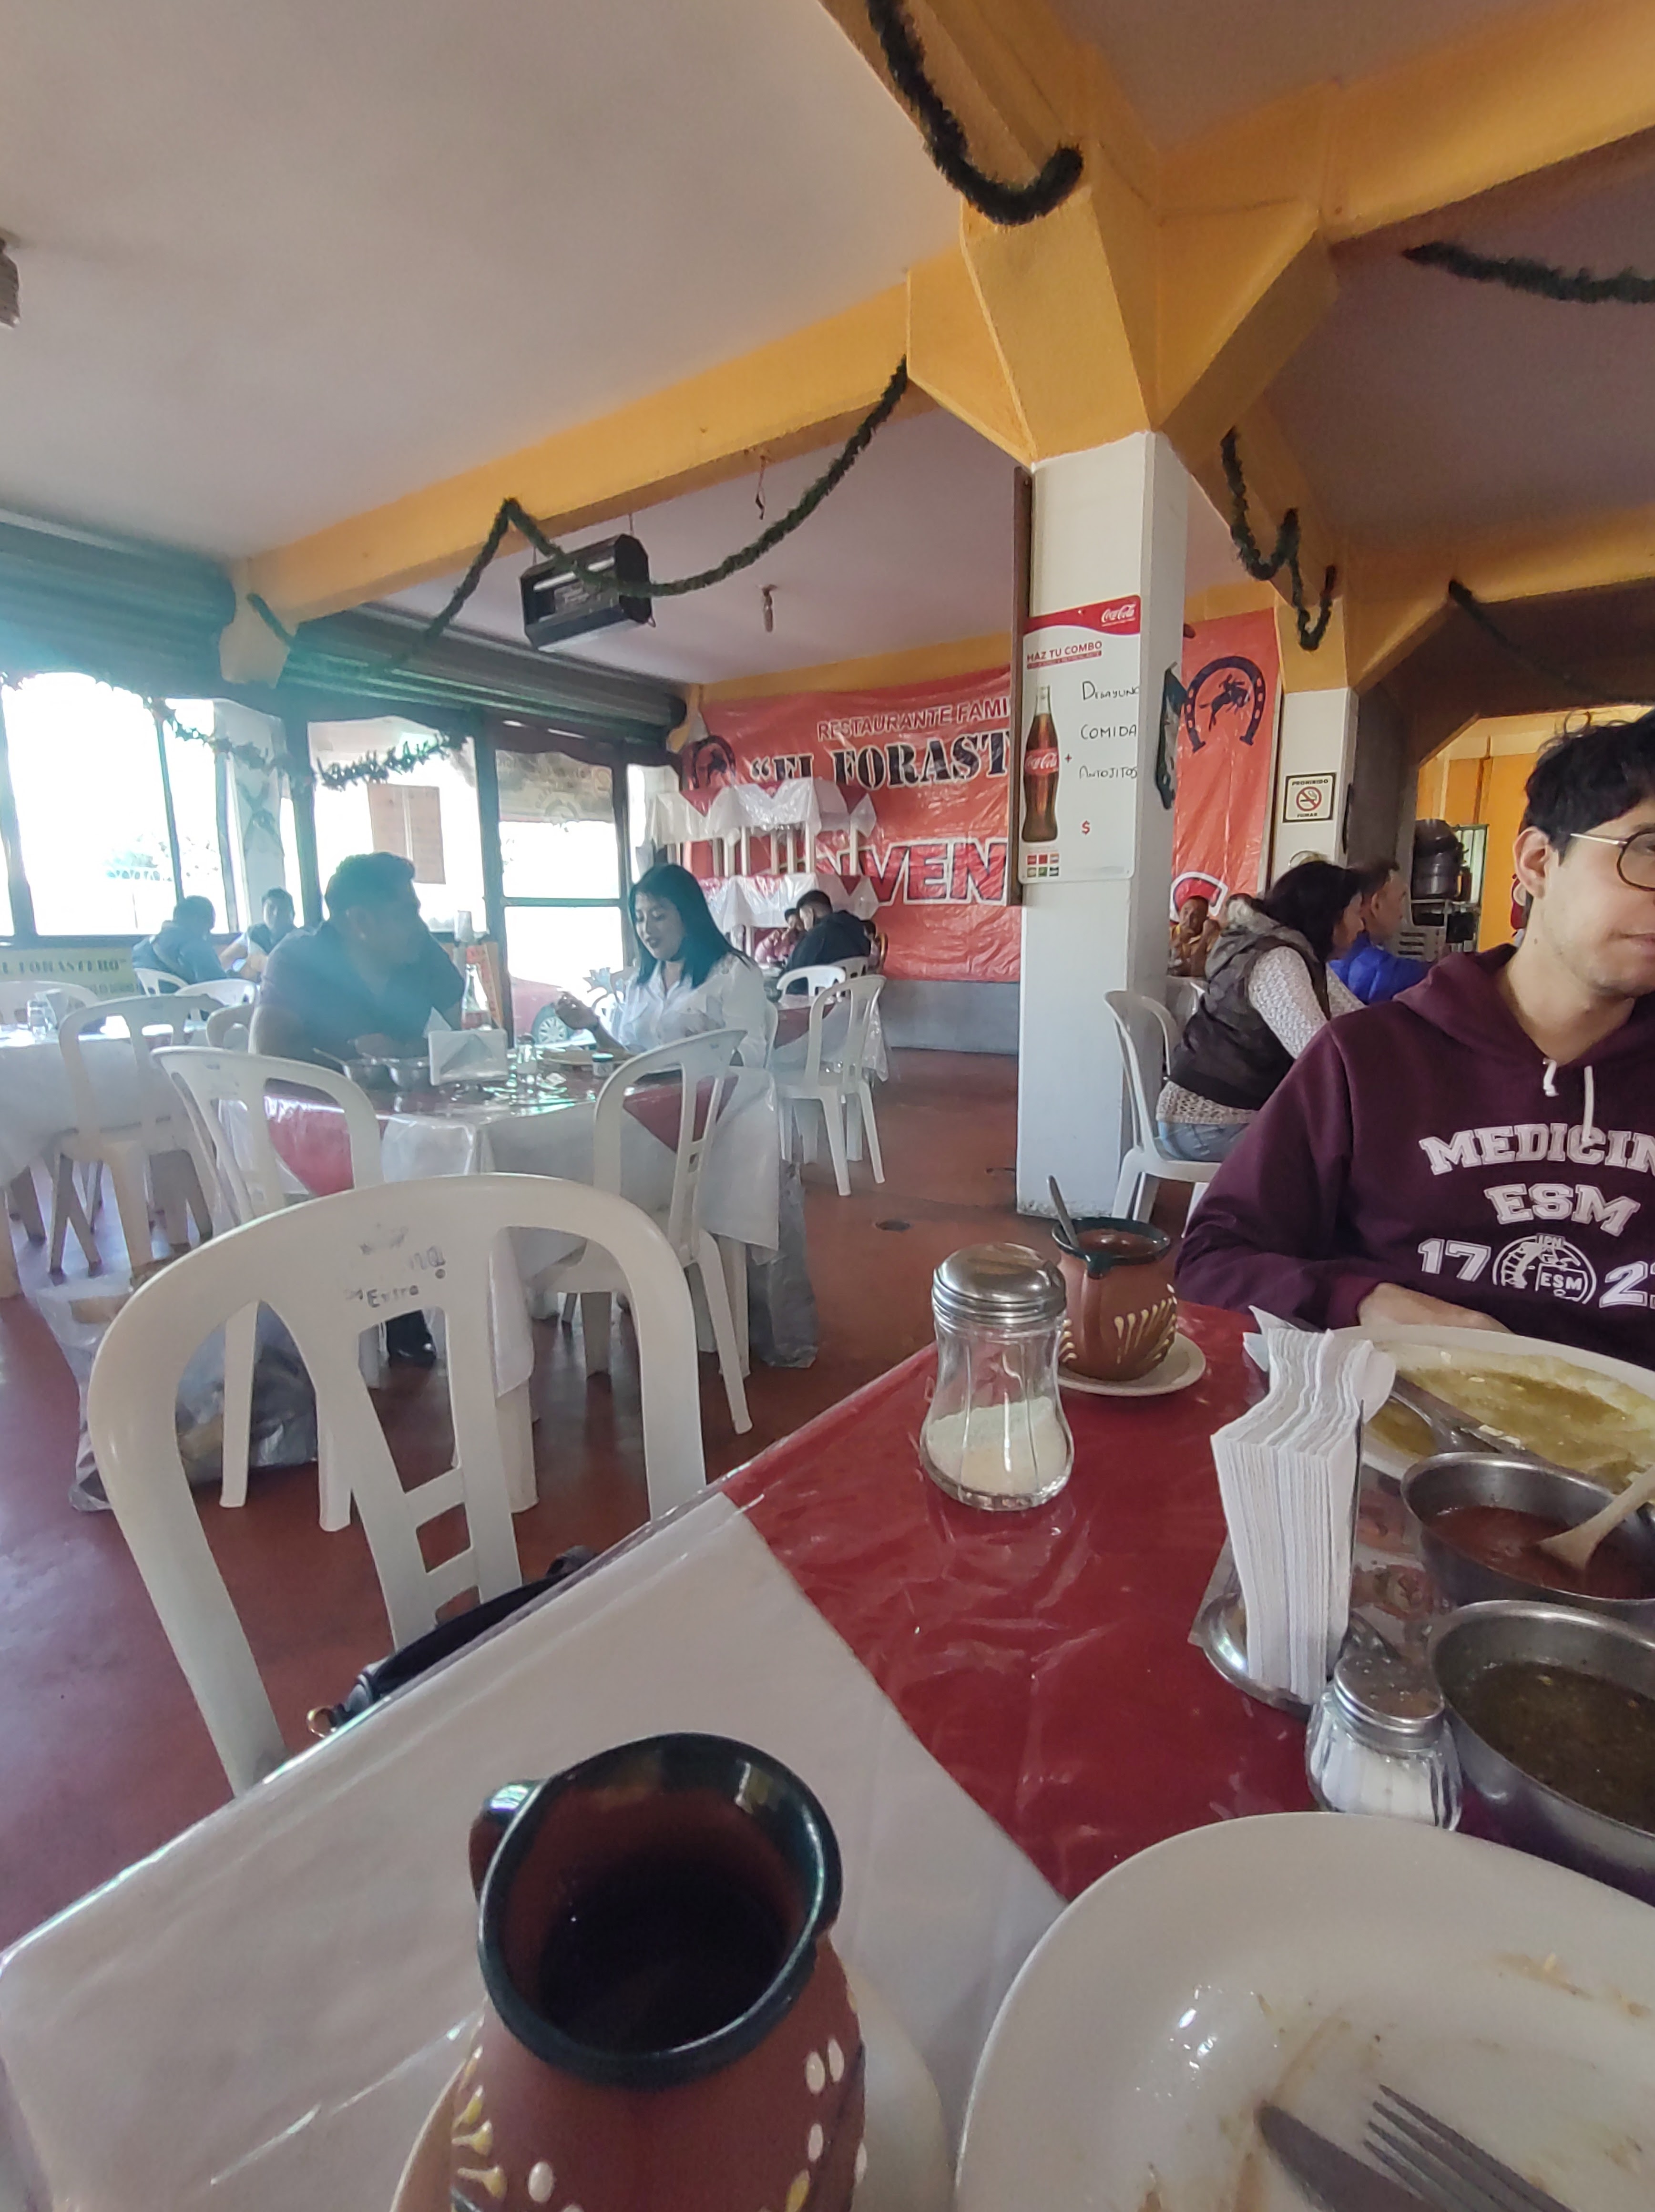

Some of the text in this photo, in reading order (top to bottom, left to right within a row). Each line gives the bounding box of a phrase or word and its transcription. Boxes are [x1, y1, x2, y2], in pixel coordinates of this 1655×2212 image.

[1027, 651, 1046, 662] HAZ
[1049, 648, 1062, 658] TU
[1064, 641, 1102, 655] COMBO
[817, 696, 1011, 742] RESTAURANTE FAMI
[1081, 724, 1137, 739] COMIDA
[1483, 1183, 1641, 1237] ESM
[1418, 1238, 1492, 1282] 17
[1540, 1271, 1582, 1290] ESM
[1599, 1261, 1655, 1309] 2
